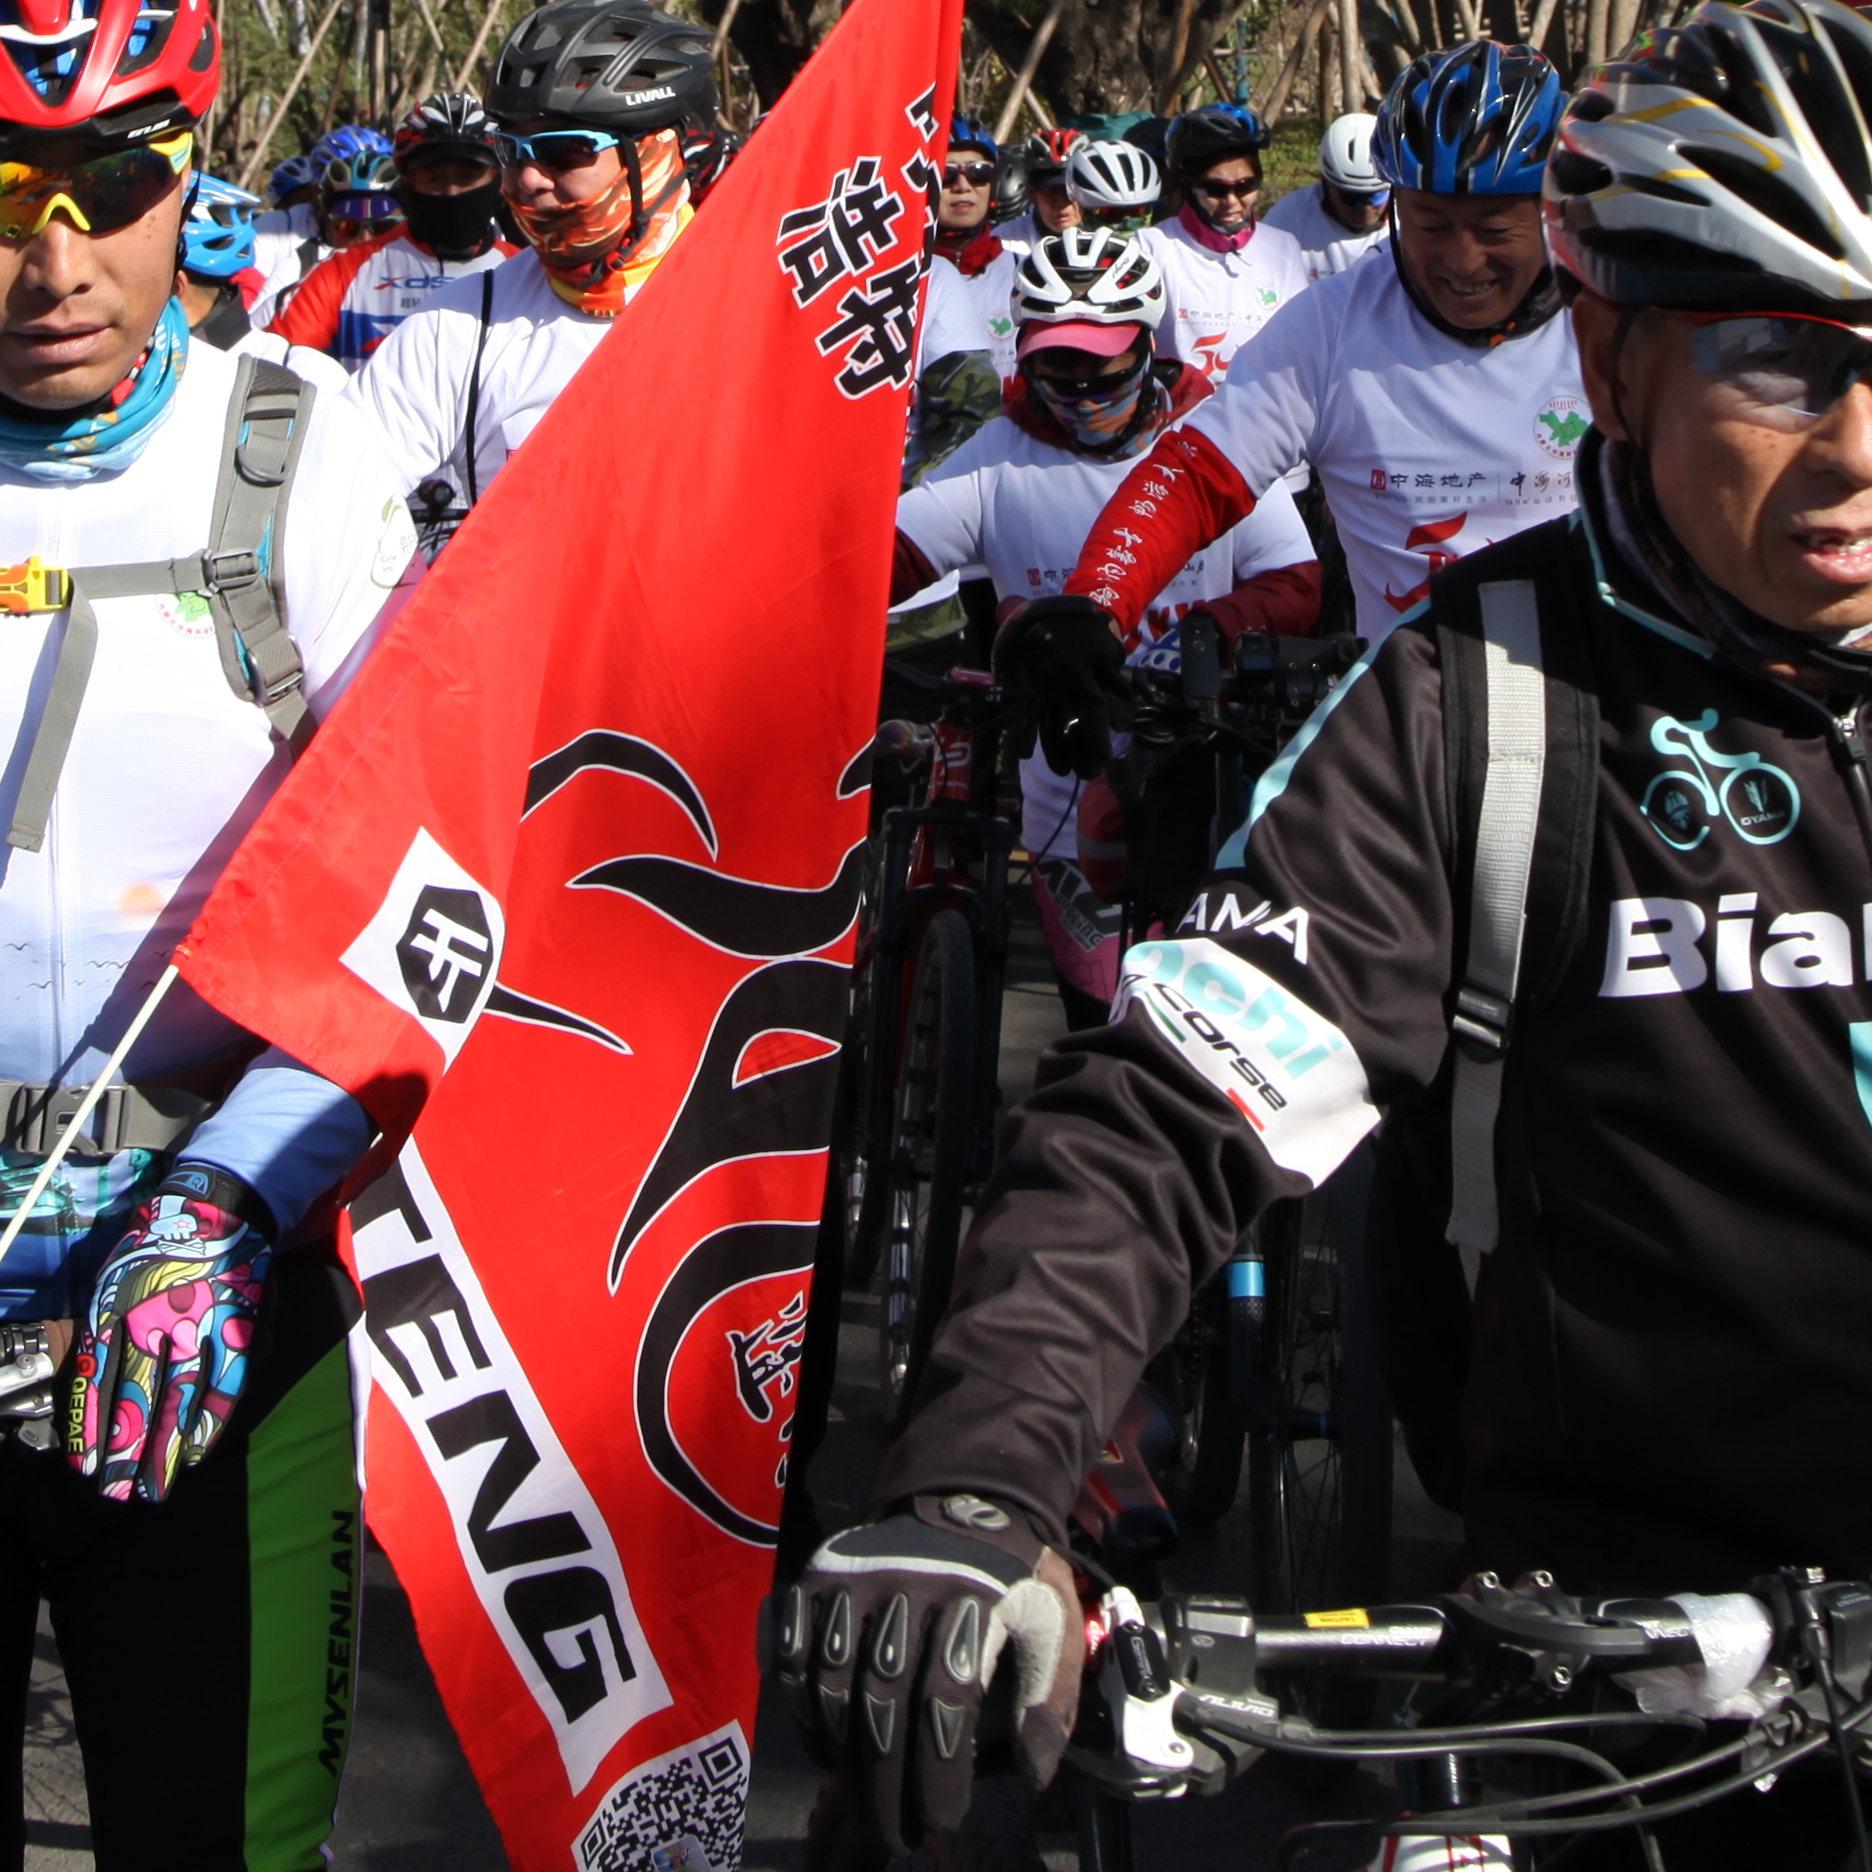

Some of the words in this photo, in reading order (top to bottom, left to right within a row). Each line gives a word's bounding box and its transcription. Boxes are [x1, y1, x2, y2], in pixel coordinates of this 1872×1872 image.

[625, 85, 677, 107] LIVALL
[1389, 473, 1487, 490] 中海地产
[1152, 982, 1288, 1111] corse
[67, 1377, 88, 1453] QEPAE
[318, 1510, 356, 1778] MYSENLAN
